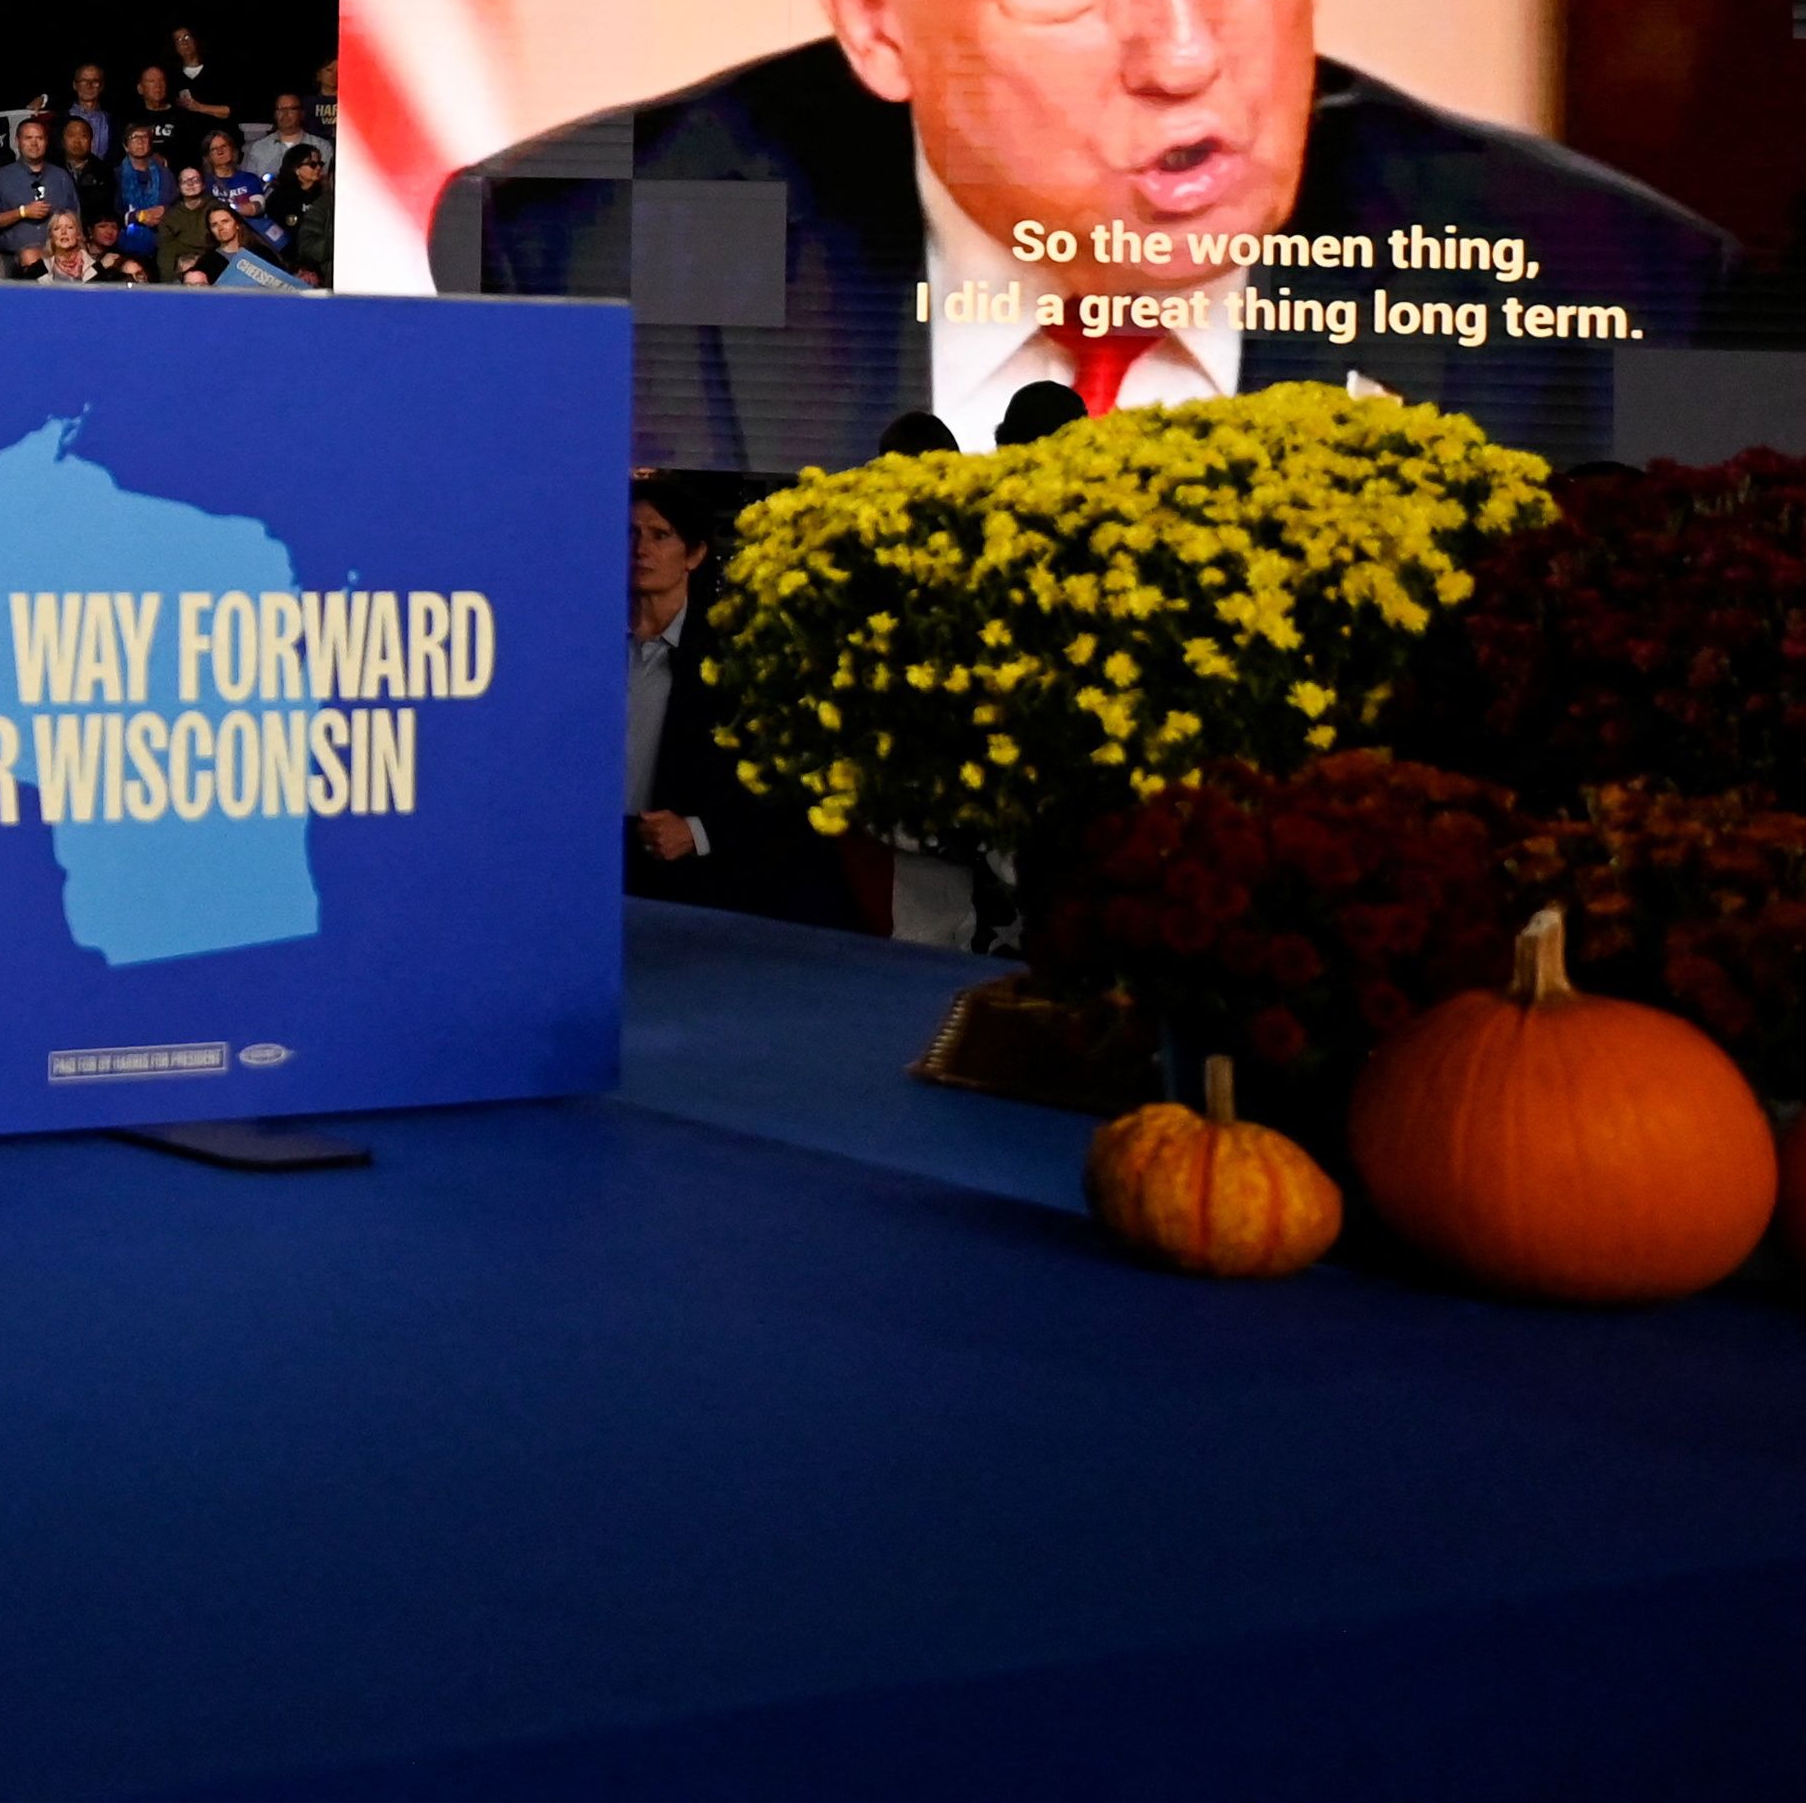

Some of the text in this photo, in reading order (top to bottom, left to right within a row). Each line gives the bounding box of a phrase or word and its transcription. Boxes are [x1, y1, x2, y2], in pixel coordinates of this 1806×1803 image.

[1012, 219, 1541, 283] So the women thing,
[916, 282, 1644, 347] I did a great thing long term.
[9, 591, 161, 705] WAY
[178, 590, 495, 703] FORWARD
[33, 707, 416, 824] WISCONSIN
